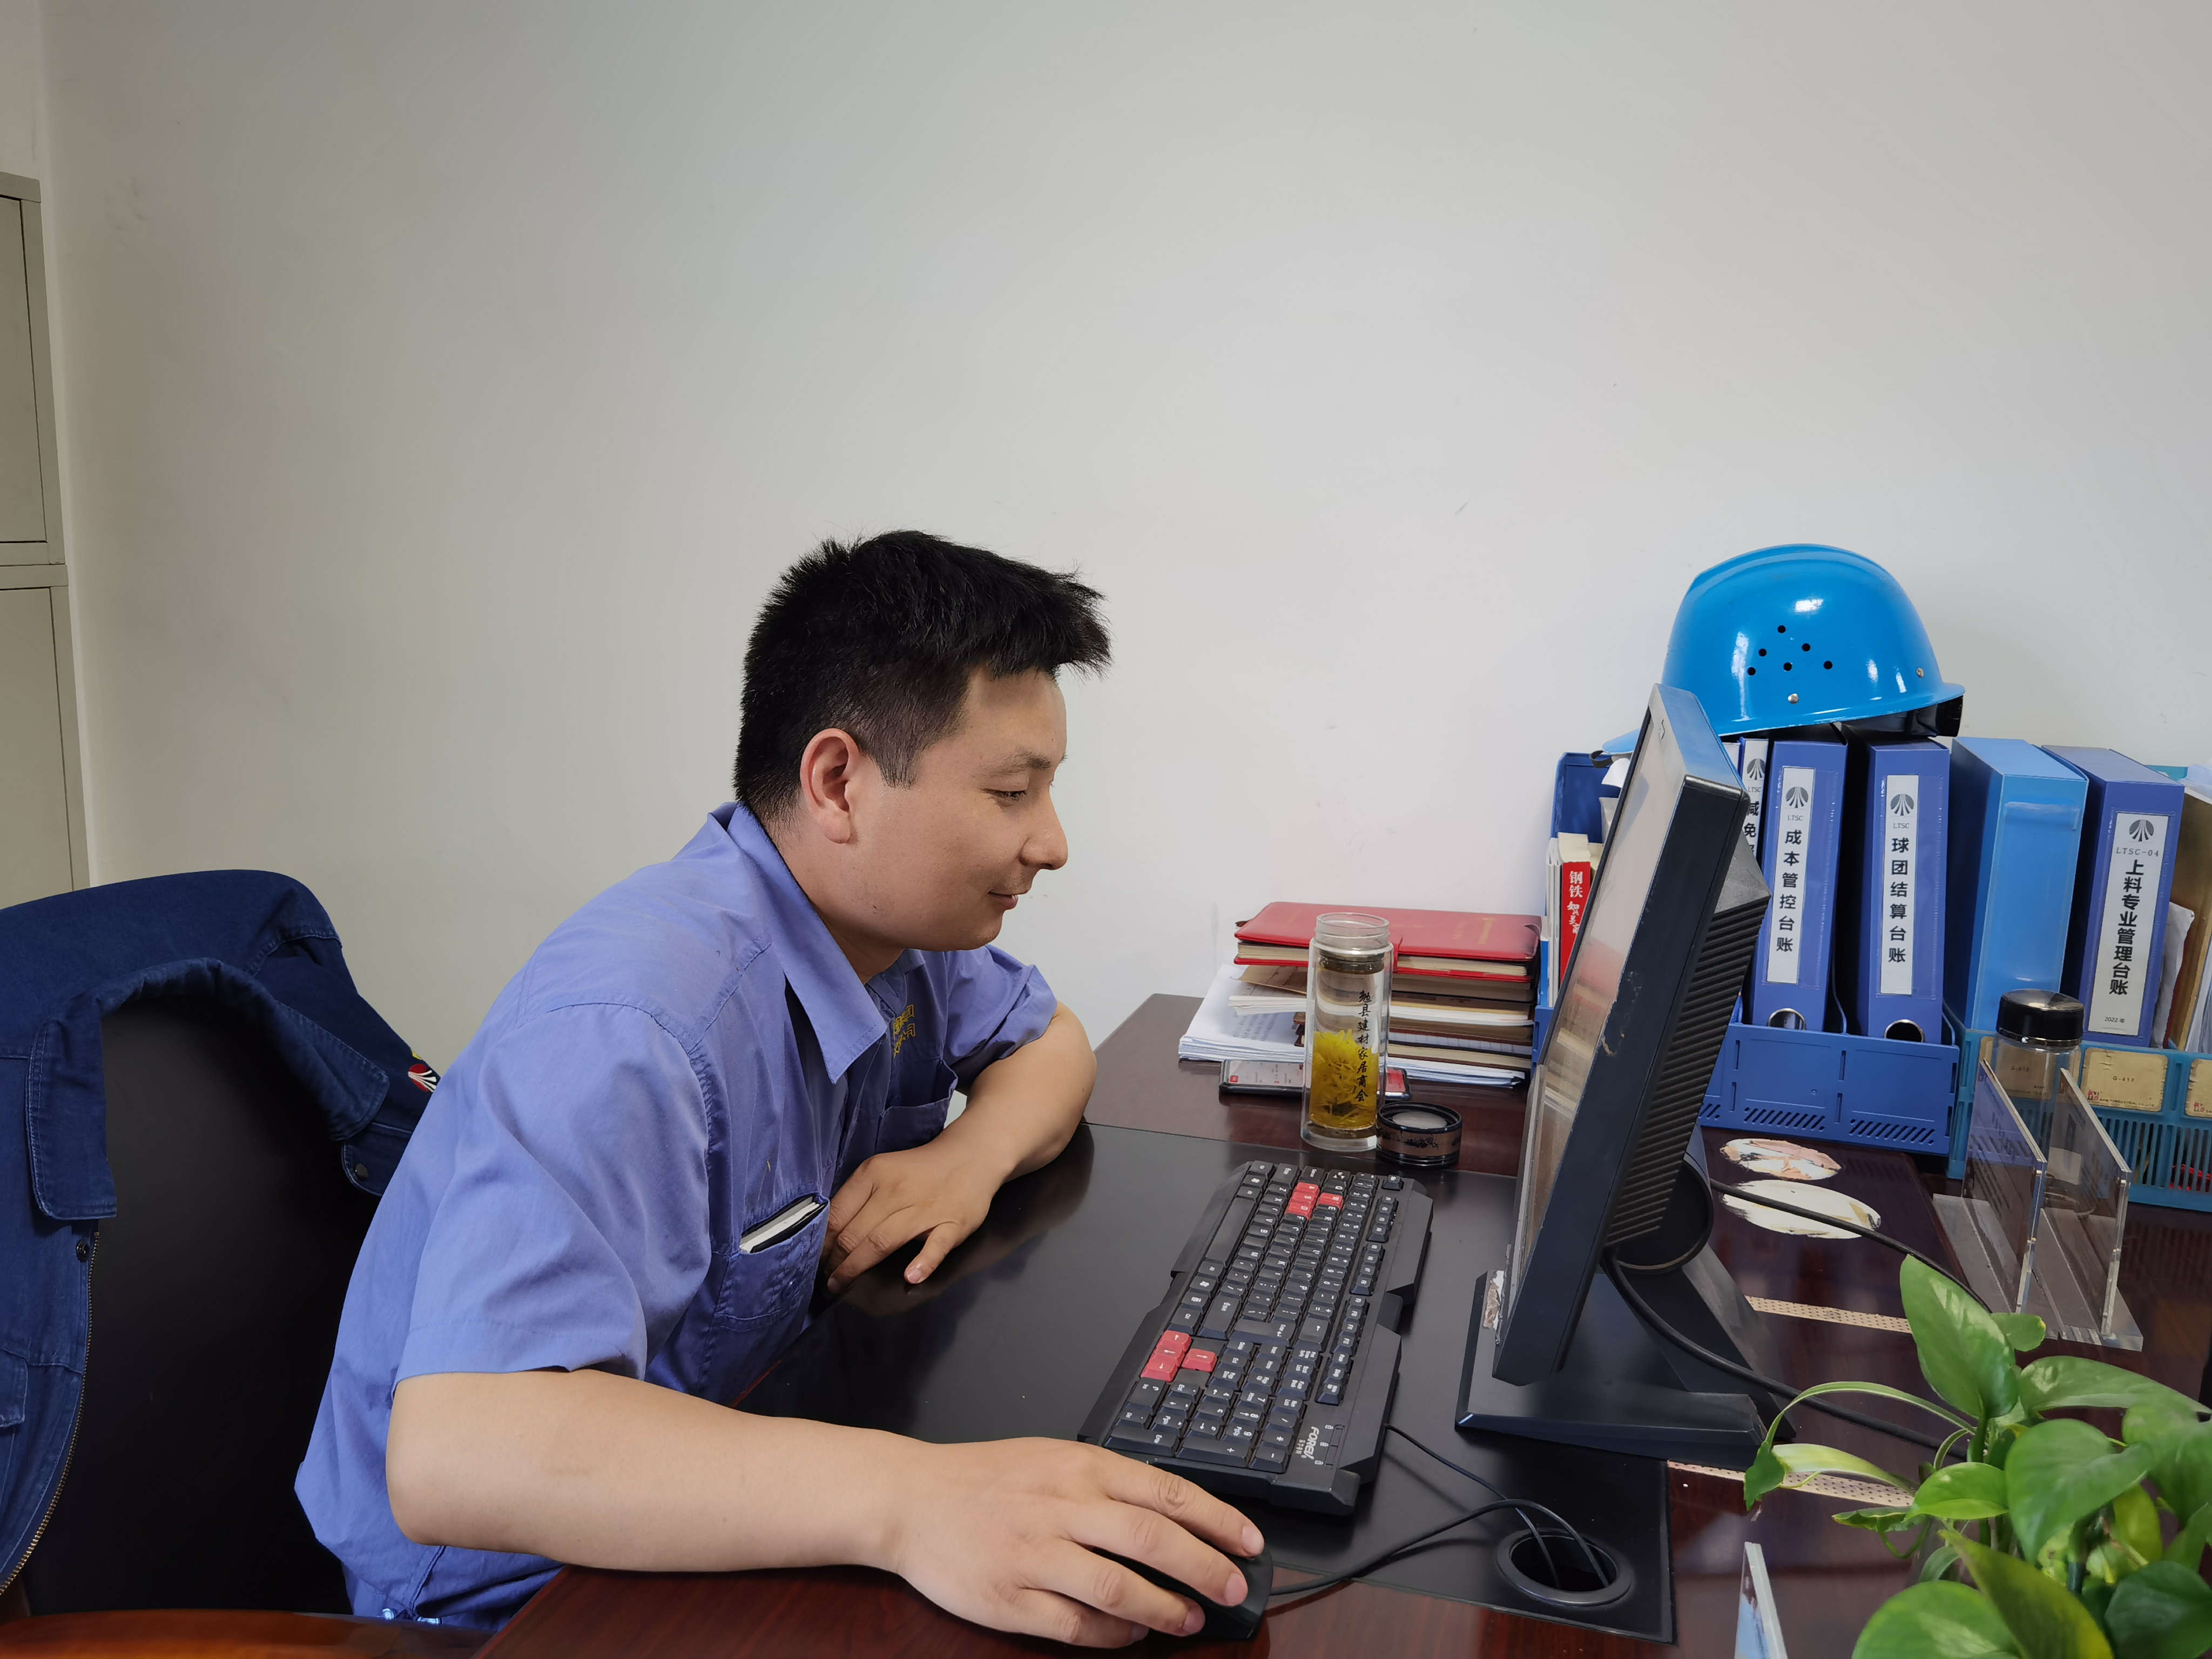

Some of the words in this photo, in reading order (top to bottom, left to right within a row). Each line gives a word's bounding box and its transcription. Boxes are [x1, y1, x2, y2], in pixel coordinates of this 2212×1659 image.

[1776, 829, 1802, 953] 成本管控台账
[1888, 837, 1910, 964] 球团结算台账
[2115, 846, 2160, 857] LTSC-04
[2109, 859, 2144, 996] 上料专业管理台账
